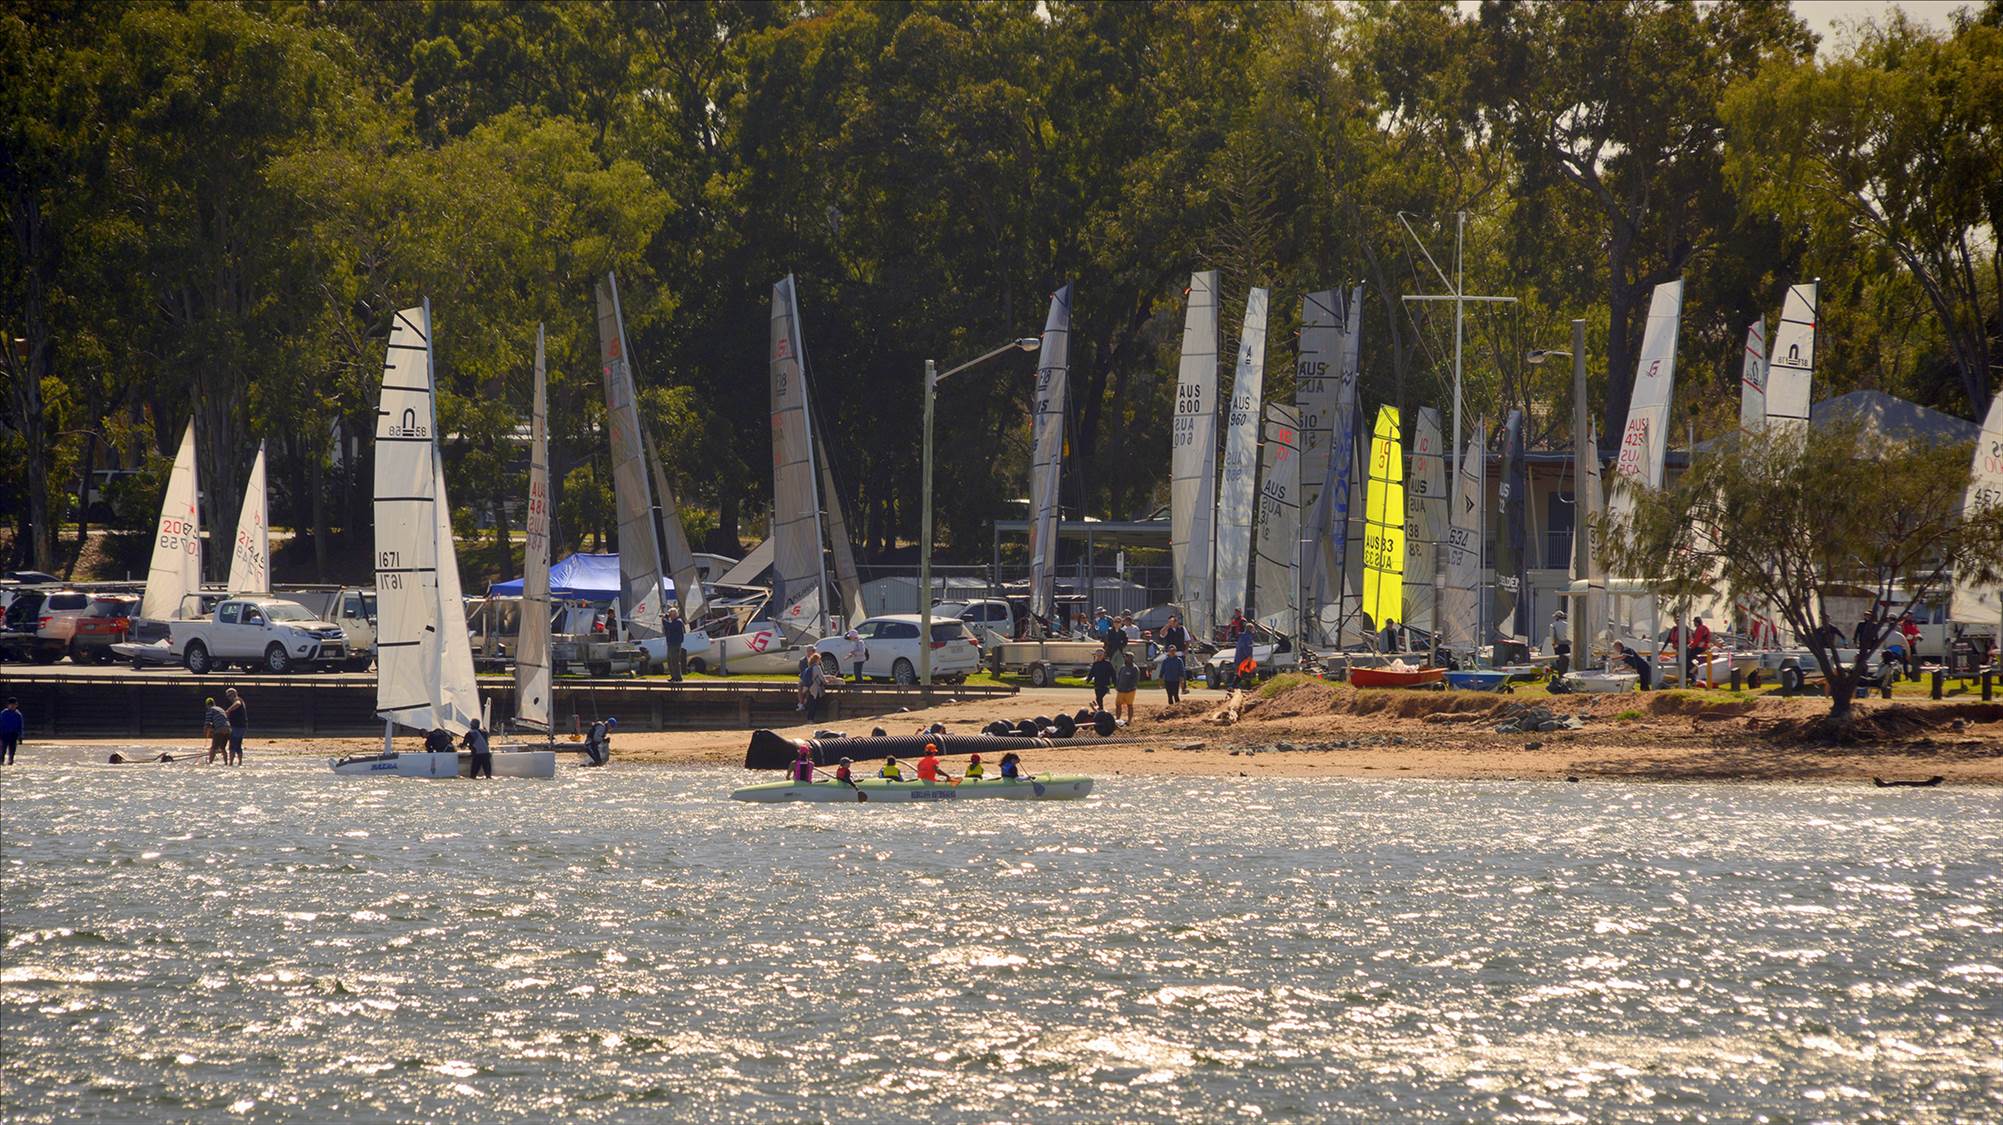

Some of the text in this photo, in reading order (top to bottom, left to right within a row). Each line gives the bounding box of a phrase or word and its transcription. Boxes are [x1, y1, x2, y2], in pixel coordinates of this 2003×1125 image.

[1300, 362, 1326, 376] AUS
[1179, 384, 1201, 398] AUS
[1179, 400, 1201, 413] 600
[1232, 396, 1251, 410] AUS
[1230, 413, 1247, 426] 960
[531, 482, 545, 498] AU
[1263, 479, 1287, 500] AUS
[1408, 523, 1420, 539] 38
[378, 552, 400, 567] 1671
